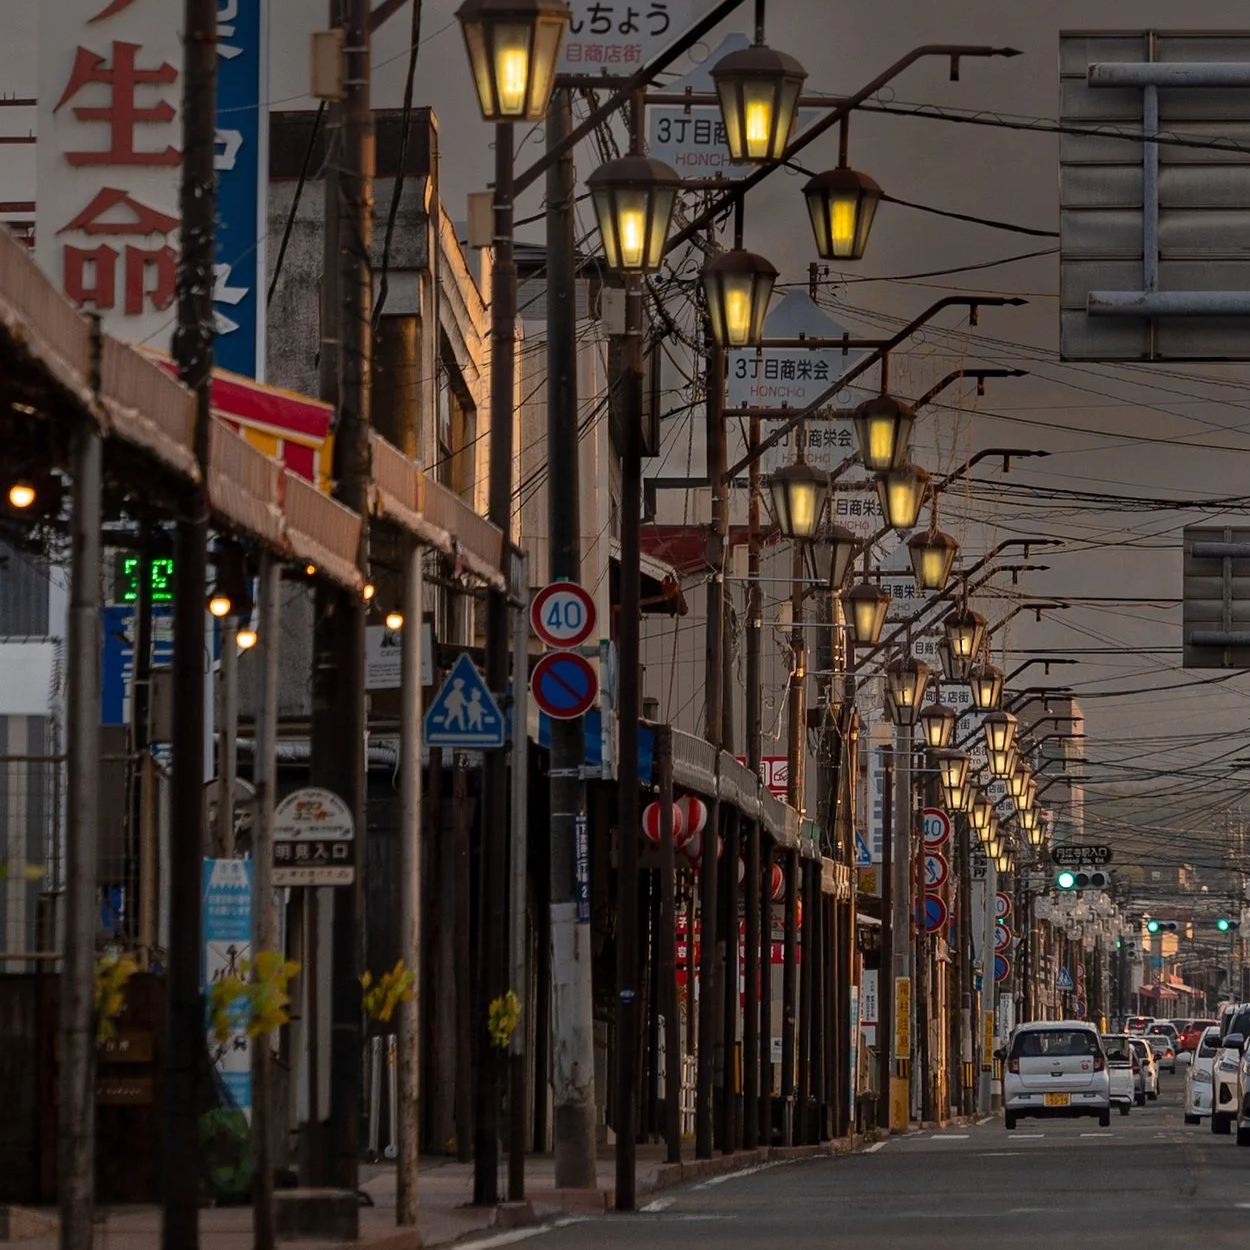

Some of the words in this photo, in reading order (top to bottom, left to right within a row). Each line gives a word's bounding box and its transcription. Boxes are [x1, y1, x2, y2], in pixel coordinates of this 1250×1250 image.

[675, 154, 736, 168] HONCH
[735, 357, 829, 381] 3丁目商栄会
[546, 600, 582, 630] 40
